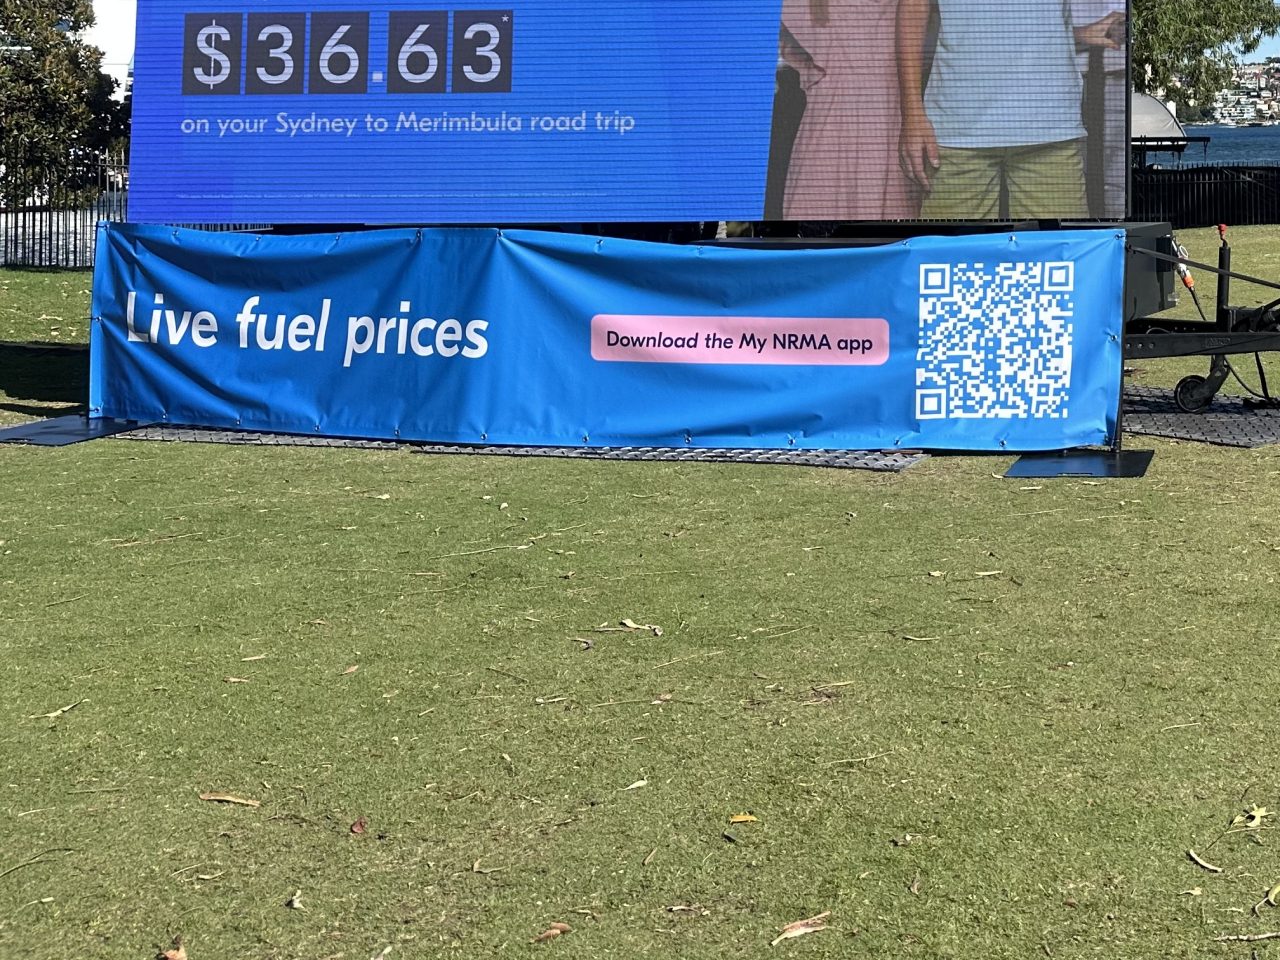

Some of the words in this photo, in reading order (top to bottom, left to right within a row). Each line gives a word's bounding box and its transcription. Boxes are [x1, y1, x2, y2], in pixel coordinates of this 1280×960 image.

[180, 118, 209, 133] on
[217, 116, 268, 138] your
[275, 112, 357, 138] Sydney
[365, 113, 389, 132] to
[395, 111, 522, 132] Merimbula
[530, 110, 586, 131] road
[594, 110, 635, 135] trip
[126, 291, 218, 348] Live
[235, 295, 331, 352] fuel
[343, 300, 489, 368] prices
[606, 330, 699, 349] Download
[704, 332, 733, 349] the
[739, 333, 767, 353] My
[773, 333, 832, 350] NRMA
[837, 339, 873, 354] app
